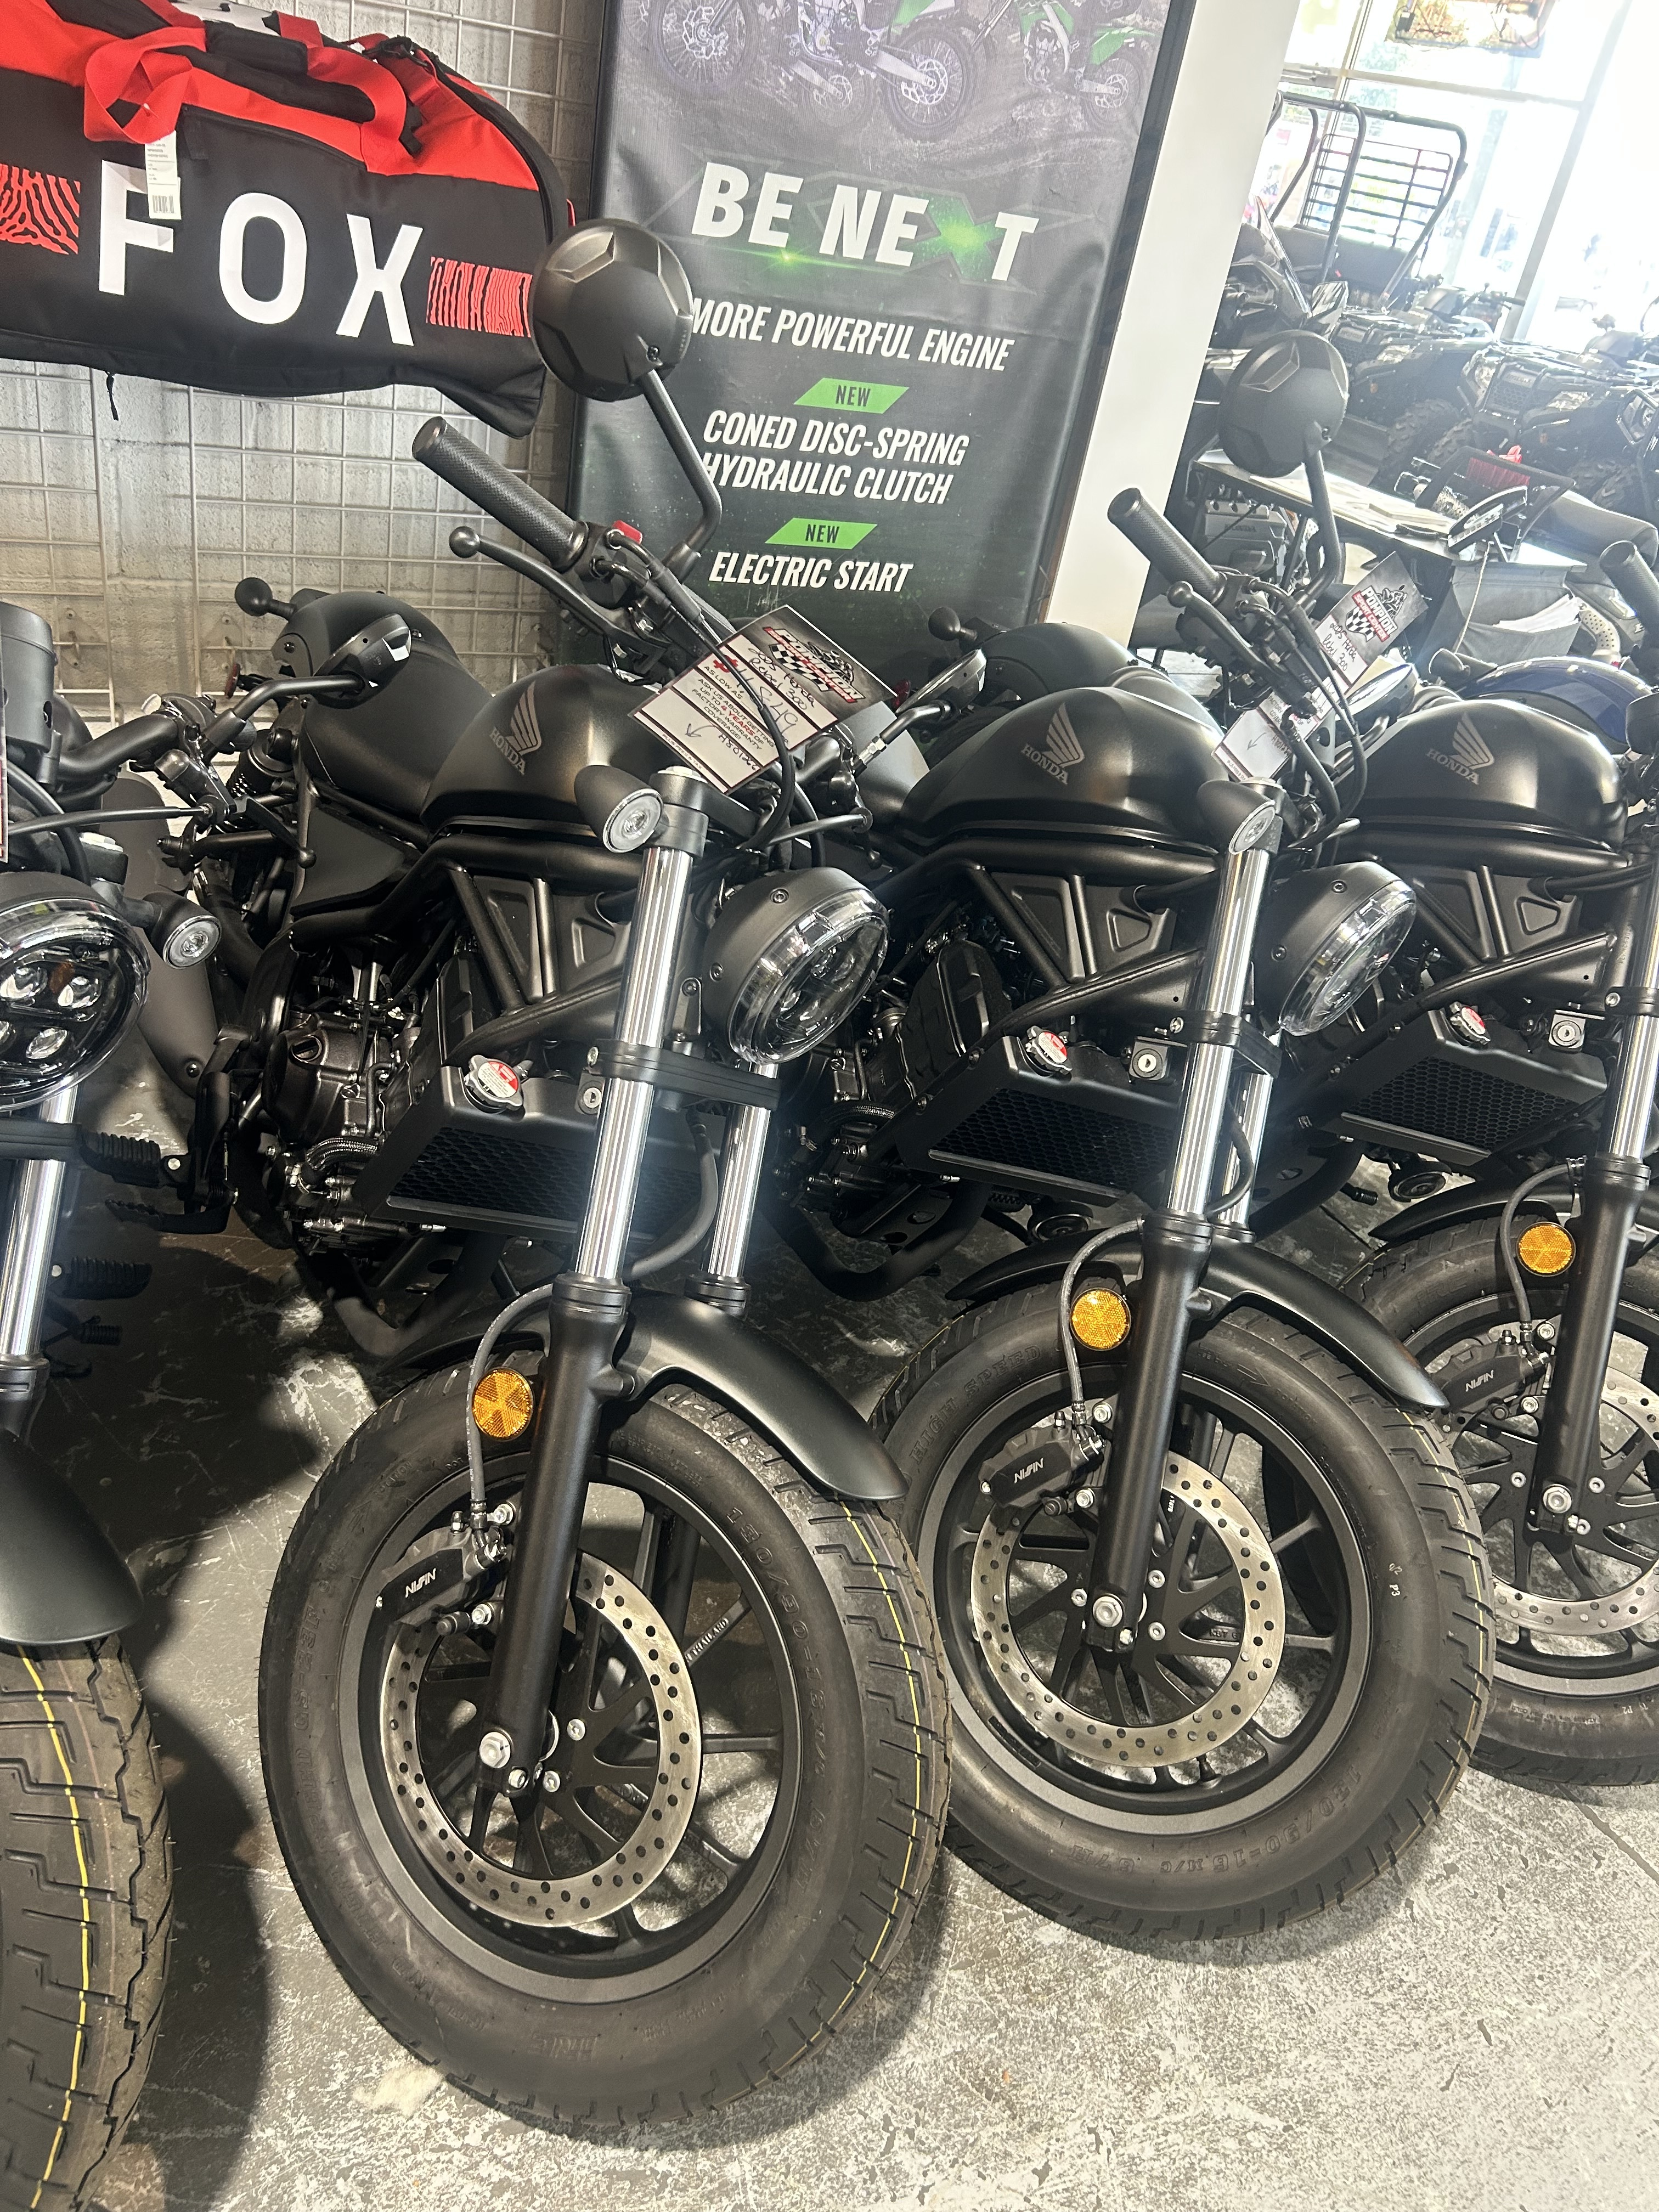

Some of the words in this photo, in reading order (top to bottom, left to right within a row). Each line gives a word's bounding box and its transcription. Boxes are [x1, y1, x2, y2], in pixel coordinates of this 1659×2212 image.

[691, 162, 803, 248] BE
[99, 159, 423, 346] FOX
[691, 298, 772, 341] MORE
[772, 310, 915, 360] POWERFUL
[918, 328, 1015, 371] ENGINE
[836, 386, 871, 407] NEW
[703, 410, 799, 451] CONED
[803, 419, 969, 466] DISC-SPRING
[702, 453, 850, 497] HYDRAULIC
[854, 467, 954, 505] CLUTCH
[805, 524, 840, 544] NEW
[709, 552, 834, 588] ELECTRIC
[835, 562, 913, 592] START
[1355, 594, 1370, 616] SPORT
[1368, 614, 1388, 640] CENTER
[1362, 586, 1398, 636] POMPION
[704, 665, 716, 675] AS
[715, 674, 732, 691] LOW
[731, 689, 744, 699] AS
[774, 629, 865, 699] POMPION
[692, 689, 725, 717] FACTORY
[724, 716, 763, 749] WARRANTY
[698, 679, 713, 692] ASK
[713, 690, 725, 700] US
[724, 698, 748, 721] ABOUT
[747, 720, 775, 748] GETTING
[700, 687, 712, 696] UP
[710, 695, 721, 706] TO
[728, 710, 755, 736] YEARS
[754, 735, 765, 745] OF
[703, 706, 742, 740] COVERAGE!
[786, 688, 808, 710] 300
[490, 727, 525, 775] HONDA
[662, 733, 675, 747] PLUS
[692, 760, 703, 770] TAX
[1020, 743, 1068, 785] HONDA
[1427, 748, 1480, 785] HONDA
[910, 1397, 958, 1465] HIGH
[963, 1345, 1041, 1398] SPEED
[445, 1457, 464, 1470] DOT
[726, 1506, 825, 1709] 130/90-16
[1212, 1764, 1362, 1872] 130/90-16
[1160, 1858, 1204, 1873] M/C
